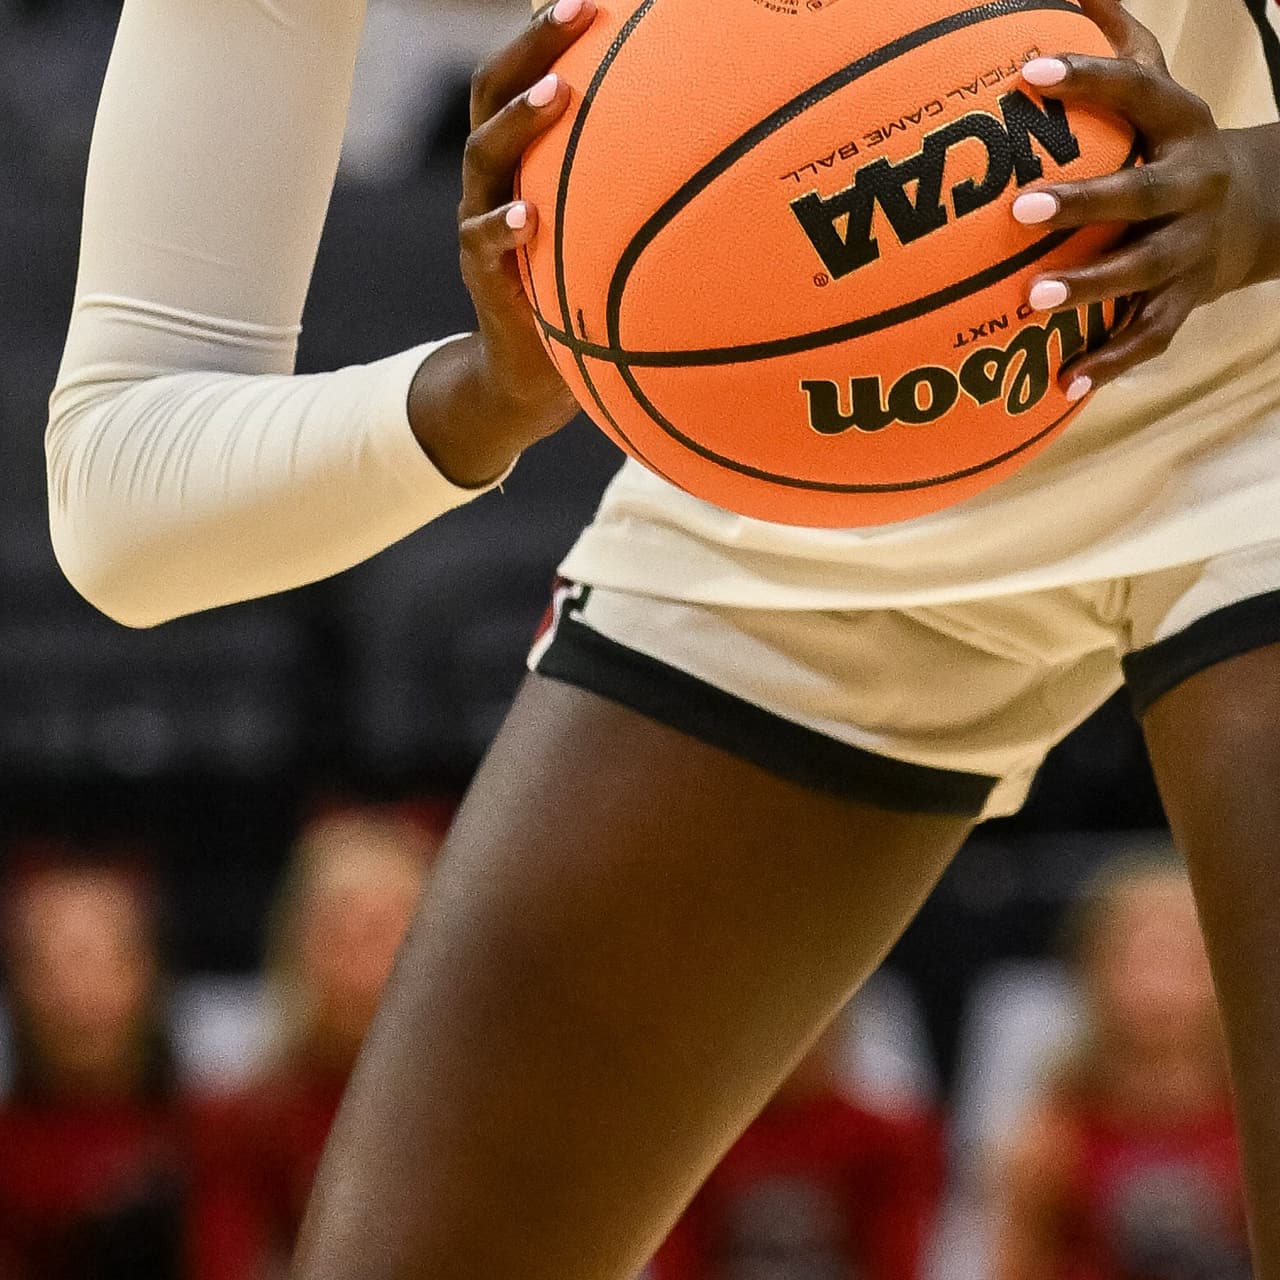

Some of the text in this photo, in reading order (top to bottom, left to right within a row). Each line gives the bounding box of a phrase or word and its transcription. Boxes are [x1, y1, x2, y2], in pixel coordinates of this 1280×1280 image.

[780, 46, 1042, 183] OFICIAL GAME BALL
[789, 88, 1081, 280] NCAA
[952, 318, 1008, 349] NXT
